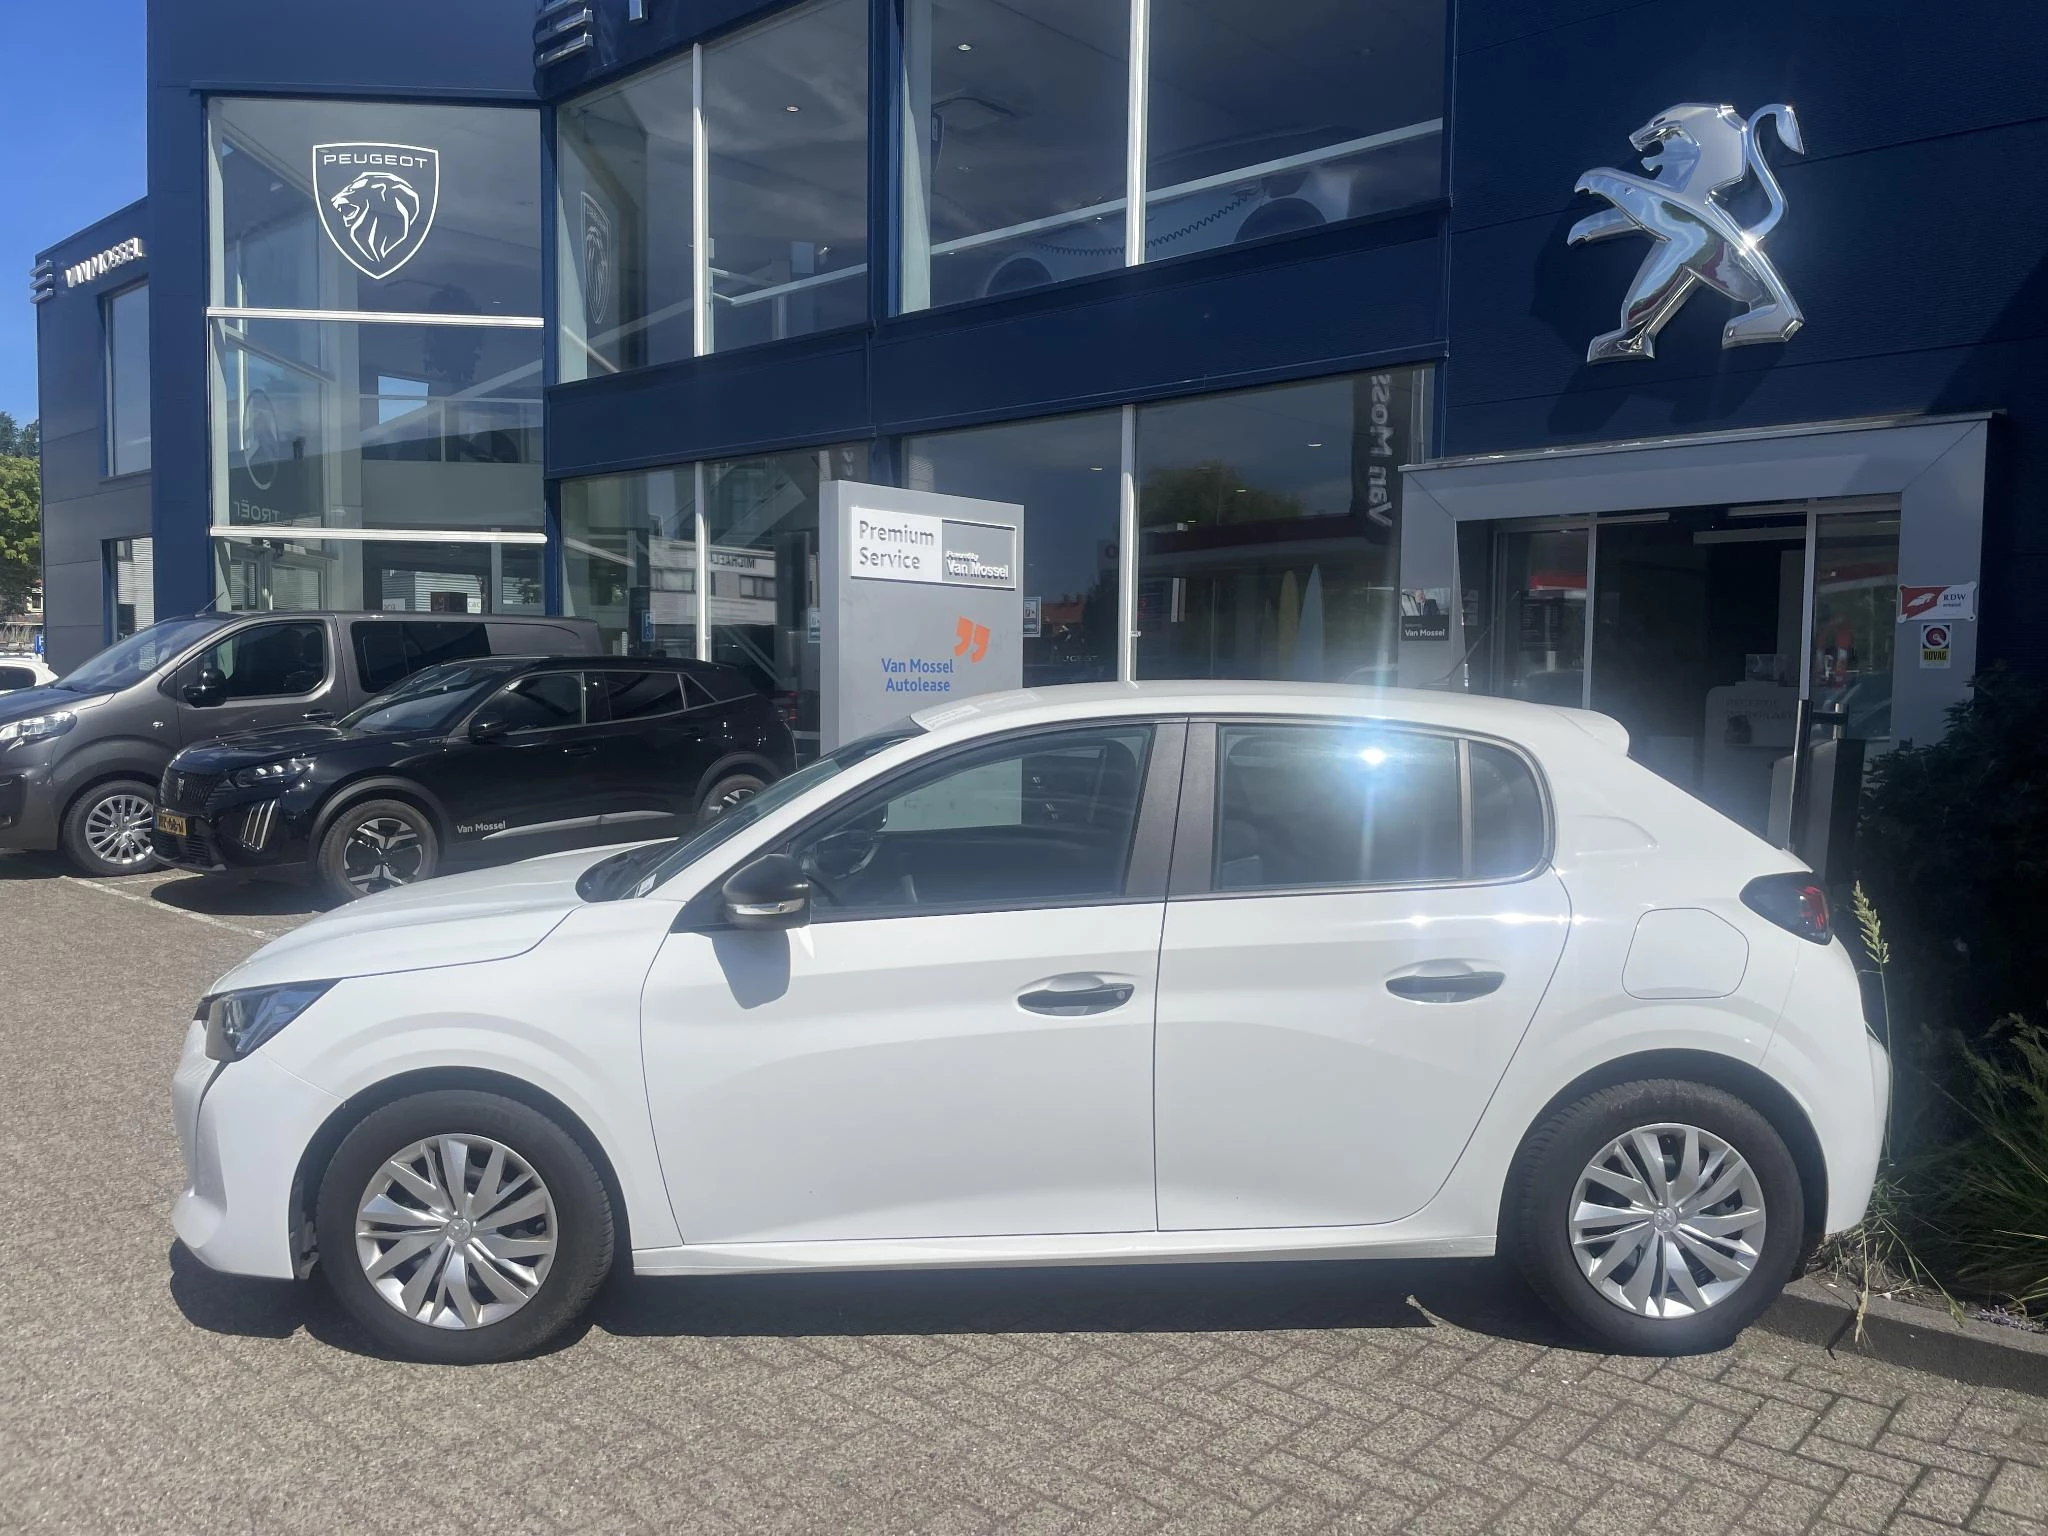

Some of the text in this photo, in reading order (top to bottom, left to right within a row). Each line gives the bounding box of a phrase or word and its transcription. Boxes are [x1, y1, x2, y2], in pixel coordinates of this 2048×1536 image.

[323, 153, 428, 168] PEUGEOT
[91, 237, 144, 276] MOSSEL
[859, 520, 935, 546] Premium
[859, 547, 921, 570] Service
[947, 559, 1009, 579] Van Mossel
[1943, 593, 1967, 601] RDW
[1405, 628, 1445, 637] Van Mossel
[881, 658, 954, 674] Van Mossel
[885, 676, 951, 692] Autolease
[456, 820, 506, 834] Van Mossel
